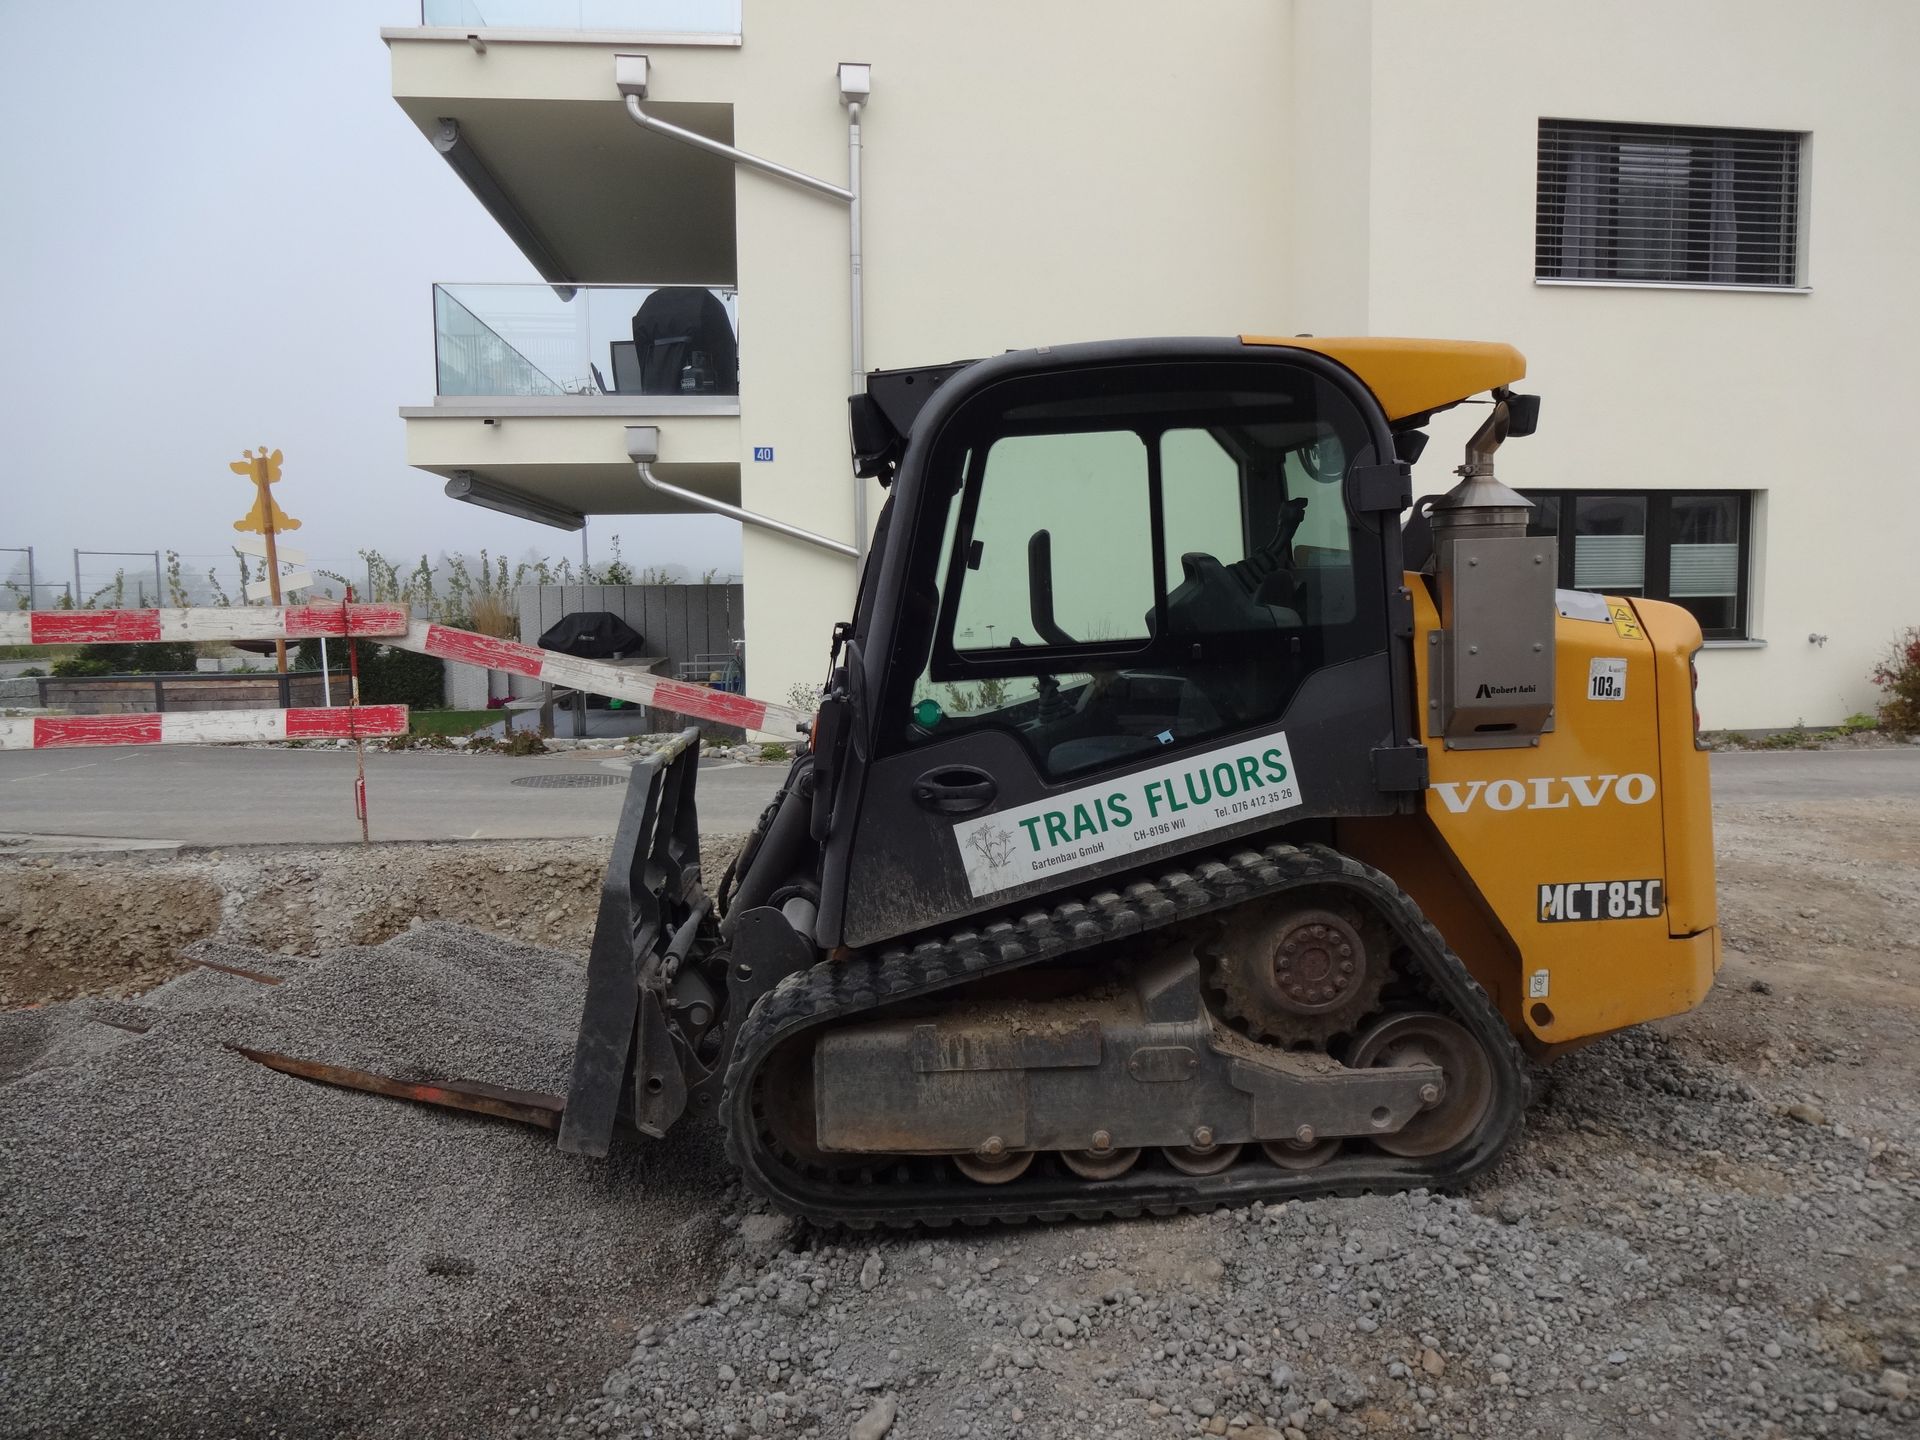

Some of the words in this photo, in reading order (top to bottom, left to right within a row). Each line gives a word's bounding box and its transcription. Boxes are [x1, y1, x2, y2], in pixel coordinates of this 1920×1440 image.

[757, 448, 771, 460] 40
[1490, 686, 1517, 695] Robert
[1592, 676, 1613, 696] 103
[1018, 792, 1133, 852] TRAIS
[1143, 748, 1288, 818] FLUORS
[1429, 773, 1656, 814] VOLVO
[1031, 851, 1077, 871] Gartenbau
[1078, 842, 1105, 857] GmbH
[1133, 821, 1170, 842] CH-8196
[1170, 818, 1186, 832] Wil
[1213, 806, 1231, 819] Tel.
[1232, 801, 1249, 814] 076
[1250, 795, 1266, 808] 412
[1268, 791, 1280, 803] 35
[1281, 788, 1293, 800] 26
[1540, 879, 1661, 921] MCT85C
